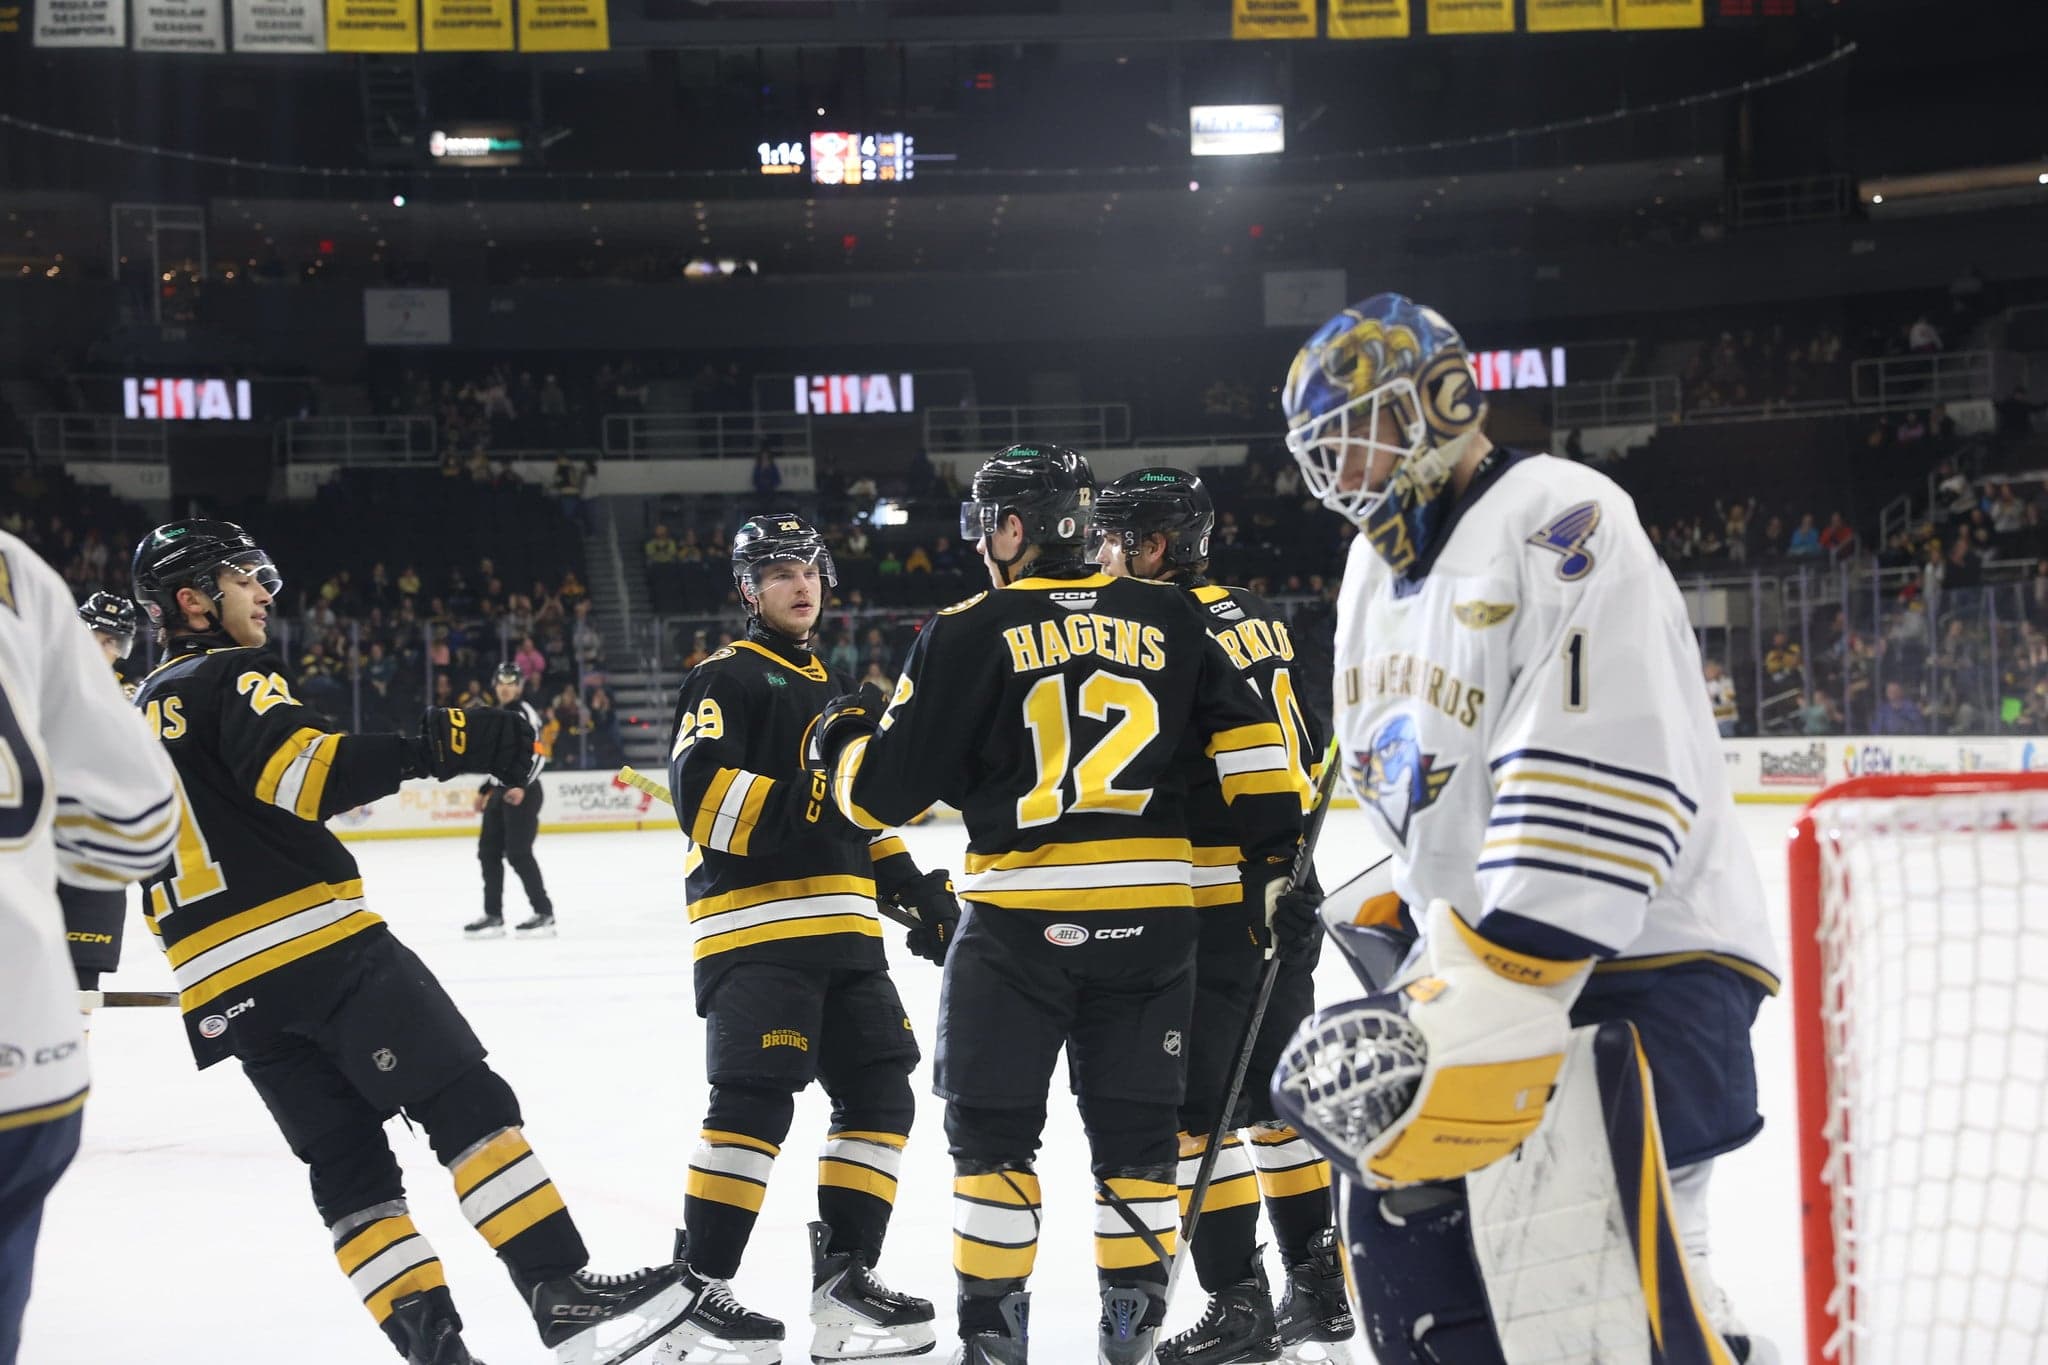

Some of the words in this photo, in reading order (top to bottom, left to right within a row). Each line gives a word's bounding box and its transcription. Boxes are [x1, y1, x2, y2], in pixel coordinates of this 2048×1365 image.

[40, 26, 116, 37] CHAMPIONS
[243, 33, 315, 45] CHAMPIONS
[141, 37, 216, 49] CHAMPIONS
[1139, 472, 1176, 483] Amica
[1050, 591, 1098, 601] CCM
[1208, 600, 1238, 615] CCM
[1002, 613, 1167, 674] HAGENS
[1564, 629, 1586, 710] 1
[447, 707, 467, 755] CC
[672, 697, 725, 763] 29
[1015, 669, 1161, 829] 12
[559, 781, 610, 797] SWIPE
[578, 796, 633, 811] CAUSE
[65, 931, 113, 944] CCM
[1094, 926, 1145, 940] CCM
[761, 1033, 809, 1052] BRUINS
